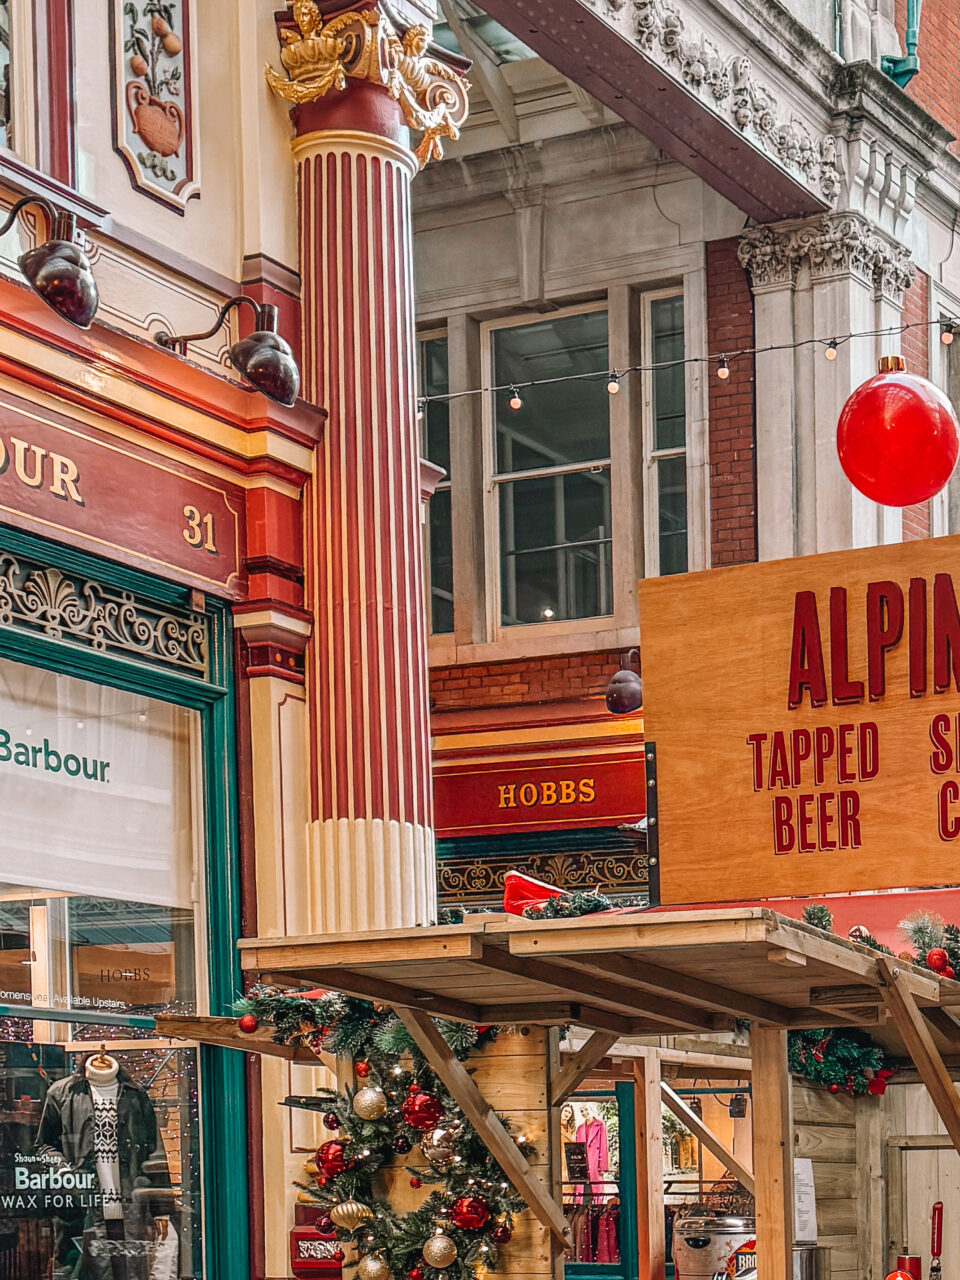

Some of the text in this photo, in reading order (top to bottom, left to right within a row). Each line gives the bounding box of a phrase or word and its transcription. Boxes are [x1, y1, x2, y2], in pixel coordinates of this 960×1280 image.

[0, 436, 85, 507] UR
[183, 505, 218, 556] 31
[747, 722, 879, 792] TAPPED
[497, 778, 596, 809] HOBBS
[772, 789, 862, 855] BEER
[100, 967, 151, 983] HOBBS
[0, 988, 31, 1001] omens
[14, 1152, 36, 1164] Shaun
[0, 1194, 111, 1209] WAX FOR LIFE
